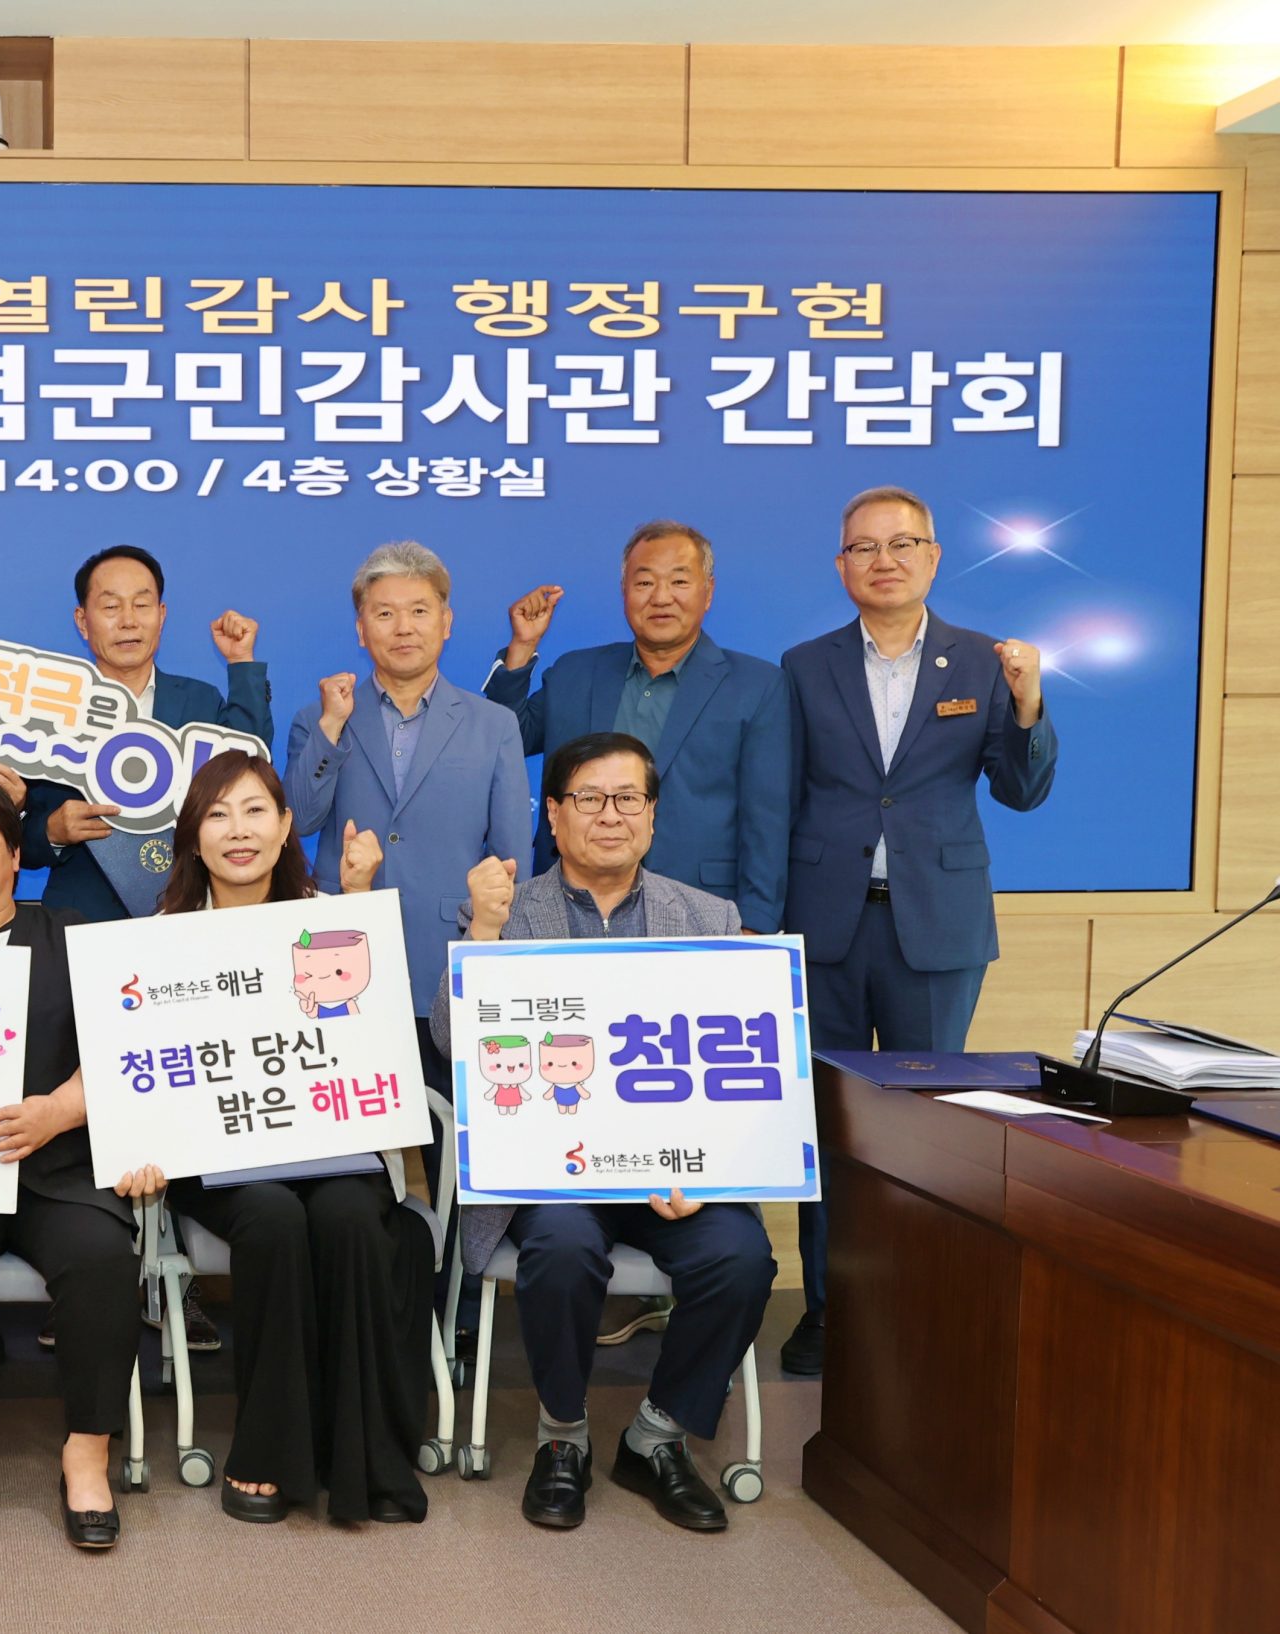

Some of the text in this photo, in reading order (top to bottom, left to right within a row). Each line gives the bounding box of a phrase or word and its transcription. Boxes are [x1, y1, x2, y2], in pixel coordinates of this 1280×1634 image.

[453, 280, 882, 338] 행정구현
[707, 351, 1061, 446] 간담회
[198, 459, 223, 495] /
[244, 458, 348, 495] 4층
[368, 458, 544, 496] 상황실
[147, 968, 263, 1000] 농어촌수도 해남
[120, 1027, 337, 1094] 청렴한 당신,
[477, 997, 782, 1102] 늘 그렇듯 청렴
[217, 1074, 400, 1135] 밝은 해남!
[590, 1148, 706, 1173] 농어촌수도 해남
